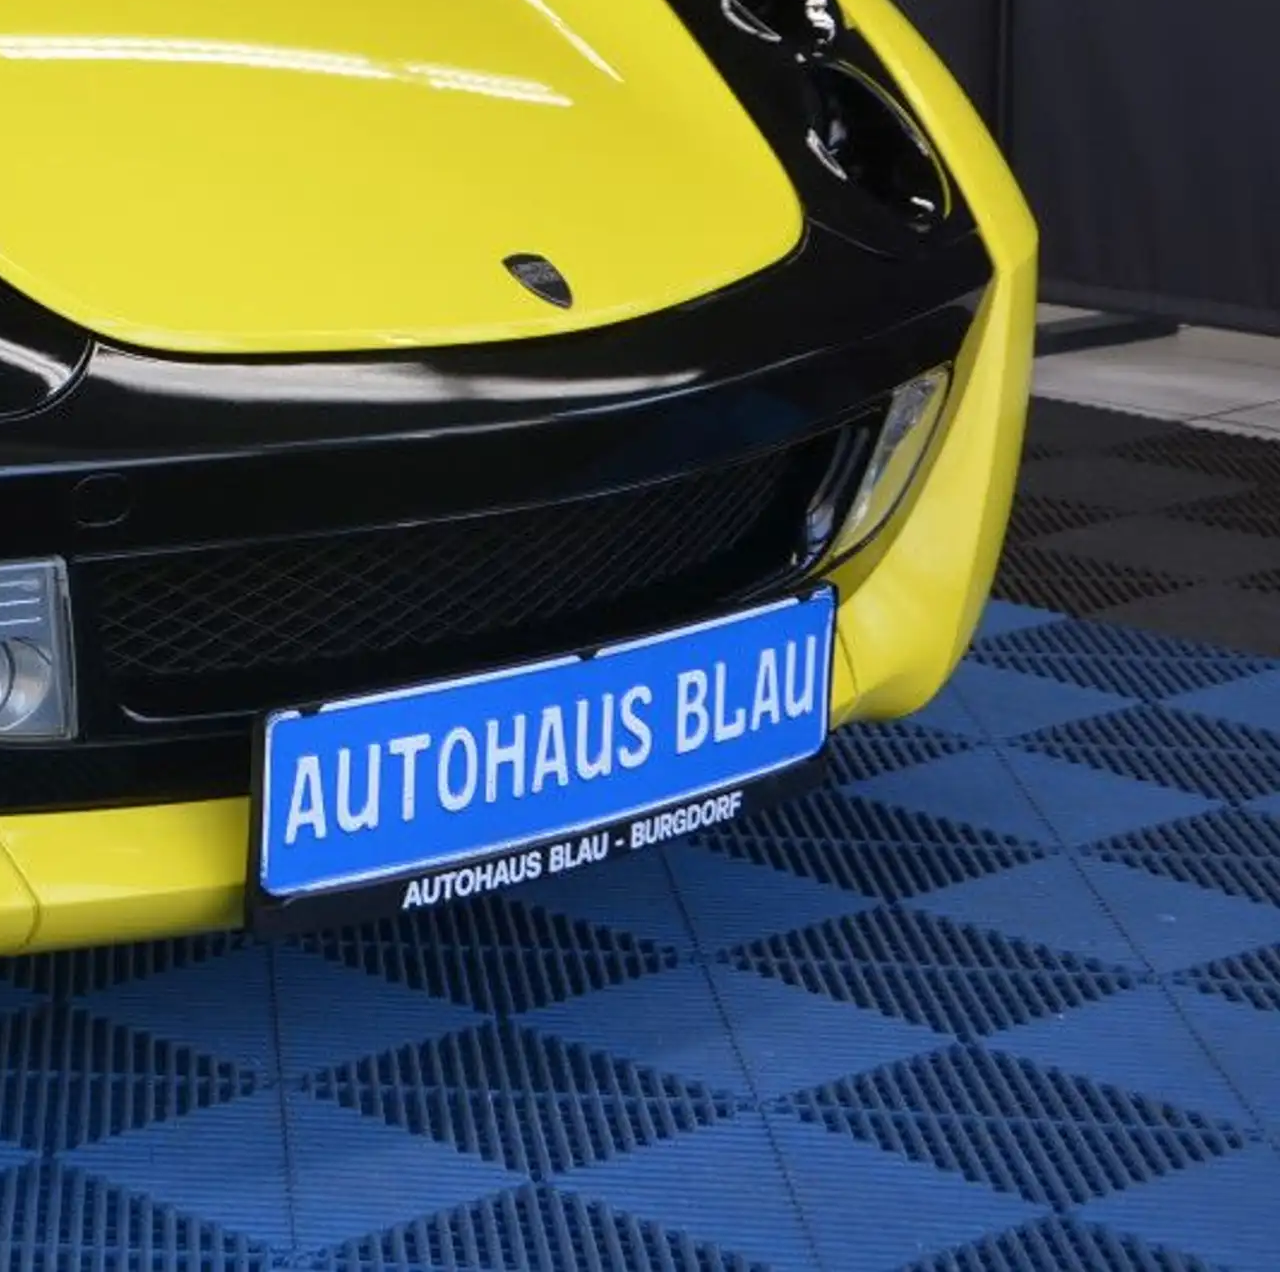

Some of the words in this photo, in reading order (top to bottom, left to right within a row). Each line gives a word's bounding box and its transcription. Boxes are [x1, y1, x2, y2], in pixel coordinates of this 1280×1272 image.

[284, 684, 653, 844] AUTOHAUS
[675, 634, 818, 753] BLAU
[402, 851, 541, 909] AUTOHAUS
[548, 832, 609, 874] BLAU
[630, 791, 743, 849] BURGDORF
